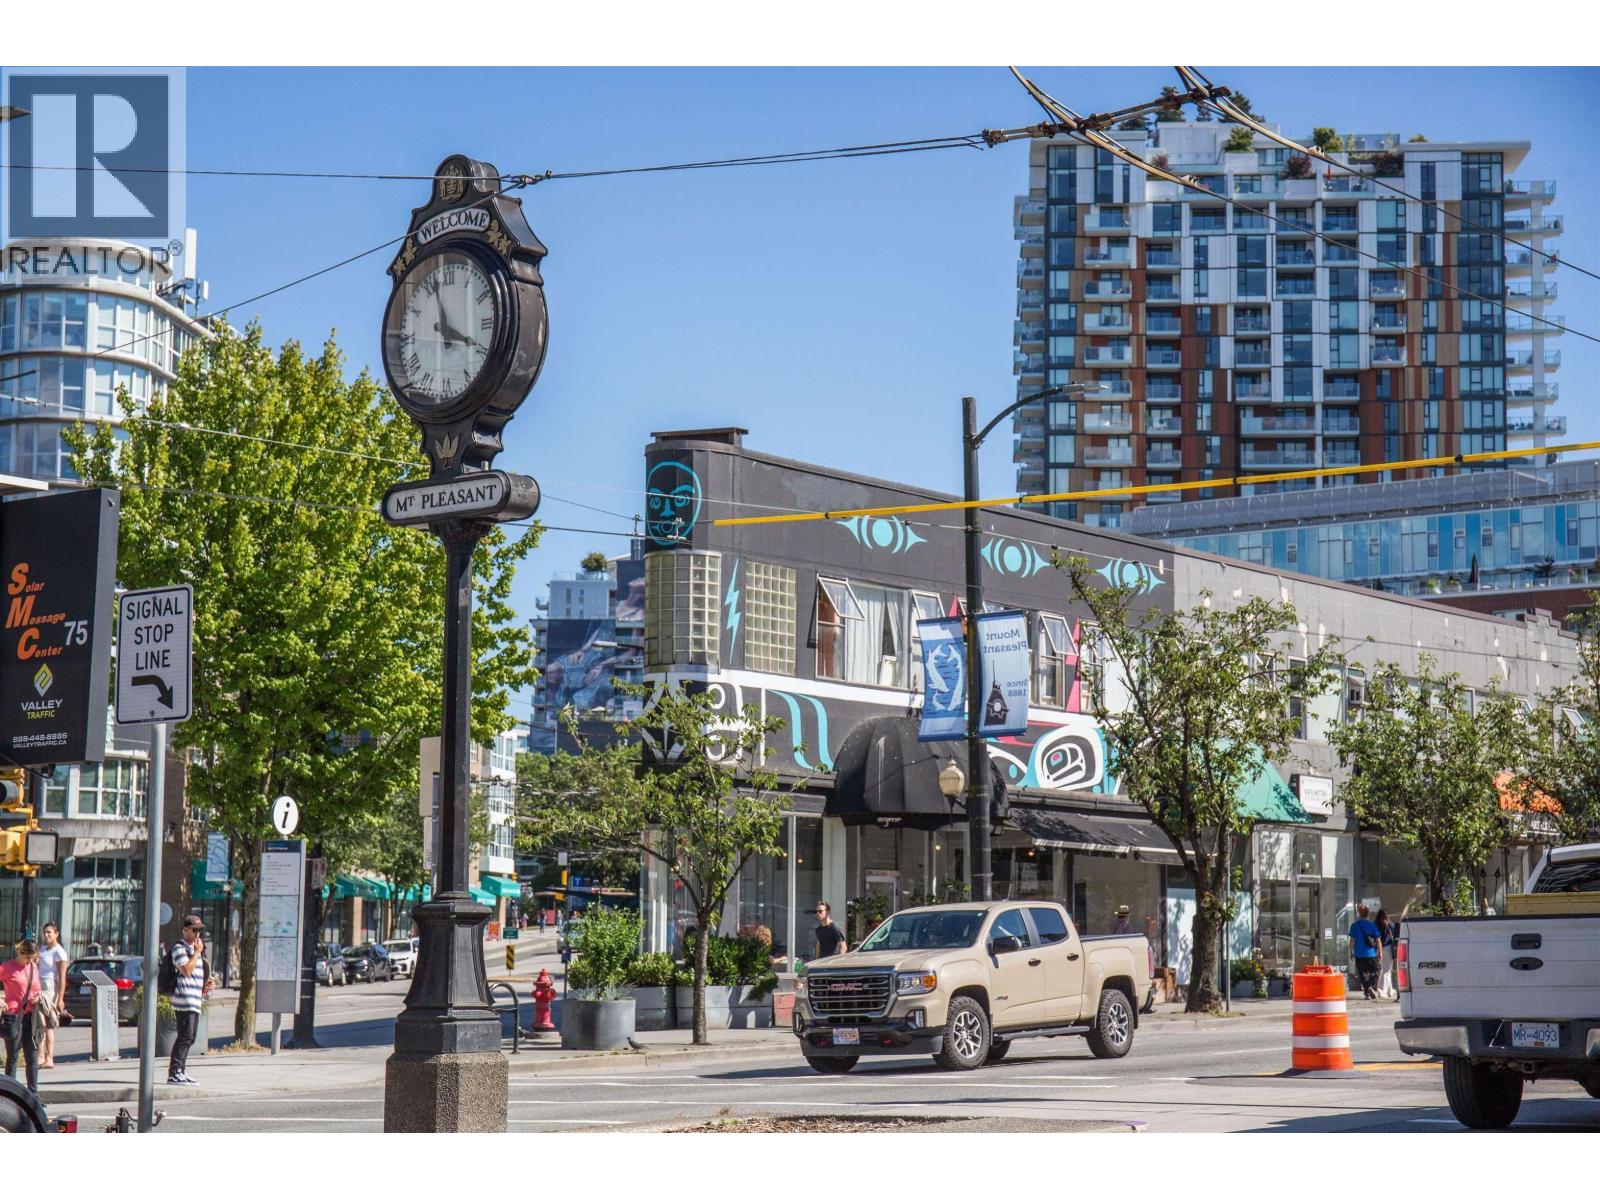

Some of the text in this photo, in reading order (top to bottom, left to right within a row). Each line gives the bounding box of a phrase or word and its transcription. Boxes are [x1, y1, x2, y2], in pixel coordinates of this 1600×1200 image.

[420, 210, 490, 241] WELCOME
[481, 317, 493, 330] III
[421, 485, 497, 510] PLEASANT
[7, 562, 45, 595] Solar
[5, 594, 66, 629] Message
[126, 596, 183, 621] SIGNAL
[17, 626, 63, 660] Center
[64, 619, 88, 646] 75
[134, 623, 174, 645] STOP
[135, 649, 171, 671] LINE
[21, 699, 63, 711] VALLEY
[27, 709, 55, 719] TRAFFIC
[13, 739, 67, 748] VALLEYTRAFFIC.CA
[830, 982, 863, 992] GMC
[1532, 1029, 1558, 1042] 4093
